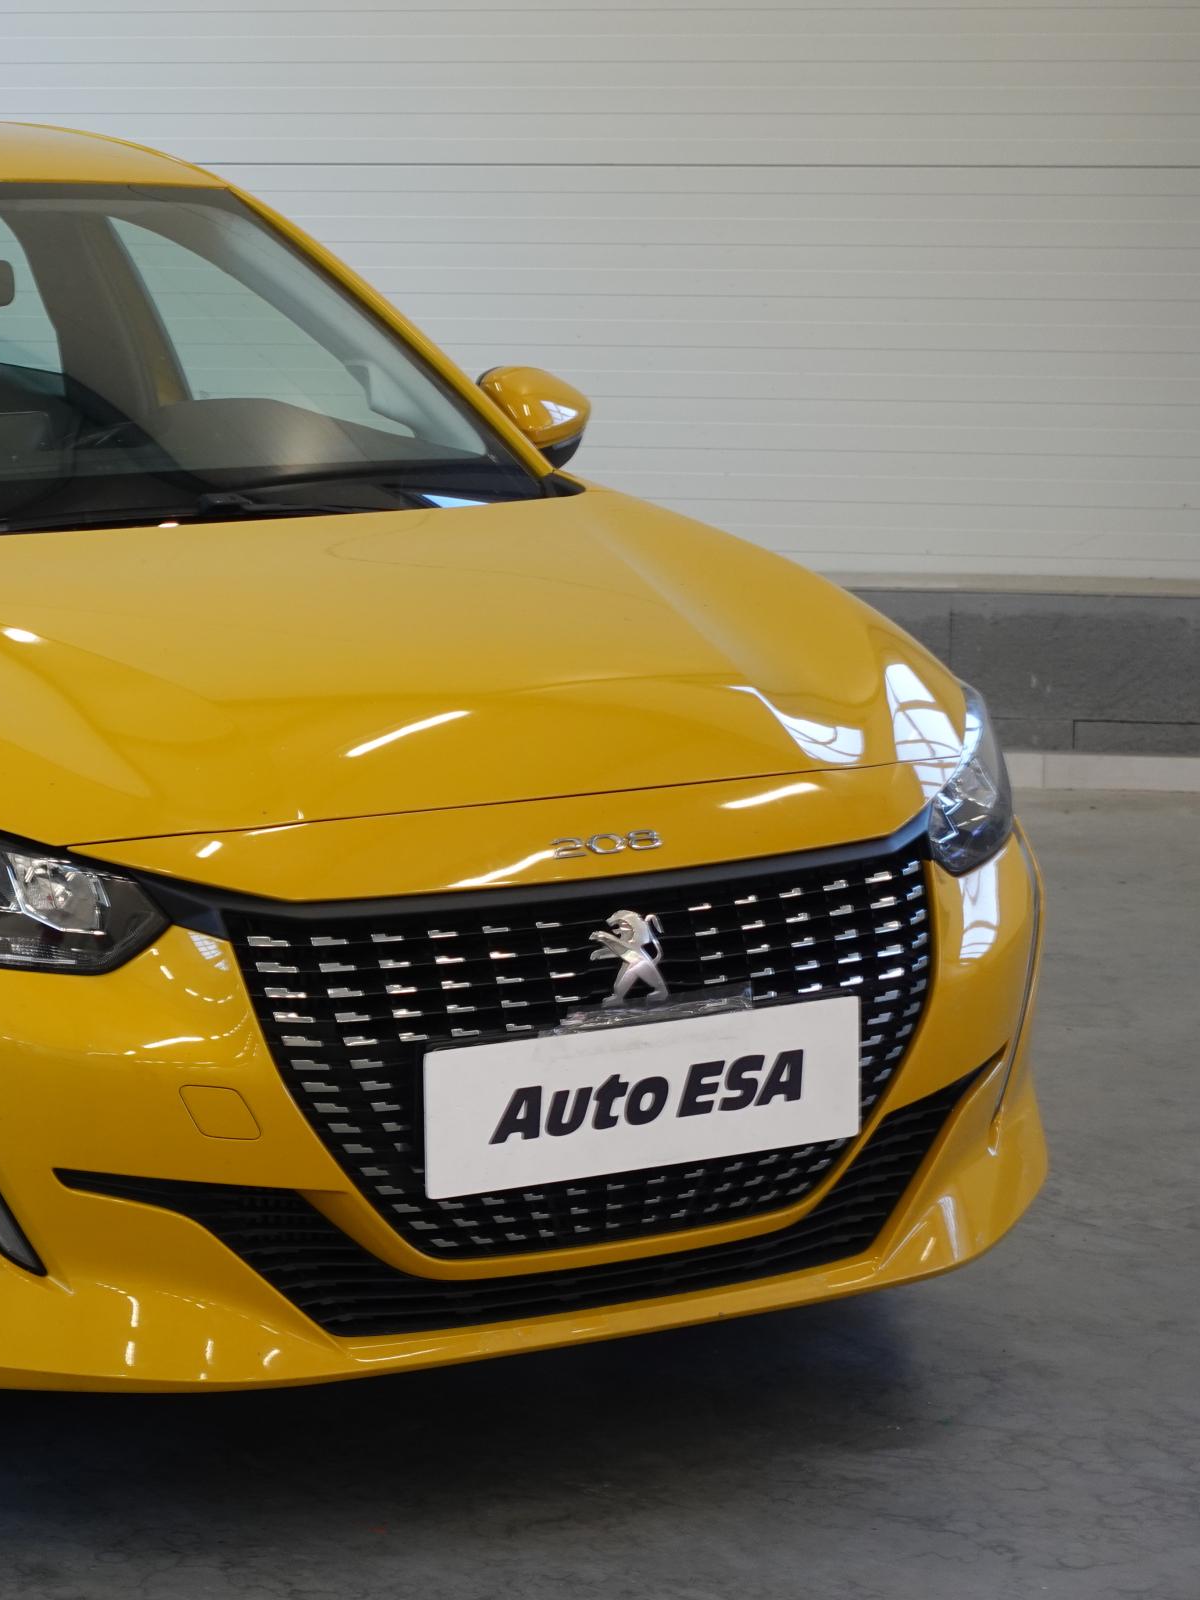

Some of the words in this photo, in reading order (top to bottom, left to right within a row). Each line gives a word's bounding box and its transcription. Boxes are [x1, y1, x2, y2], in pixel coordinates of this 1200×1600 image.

[551, 829, 663, 860] 208
[488, 1073, 669, 1144] Auto
[676, 1049, 804, 1118] ESA
